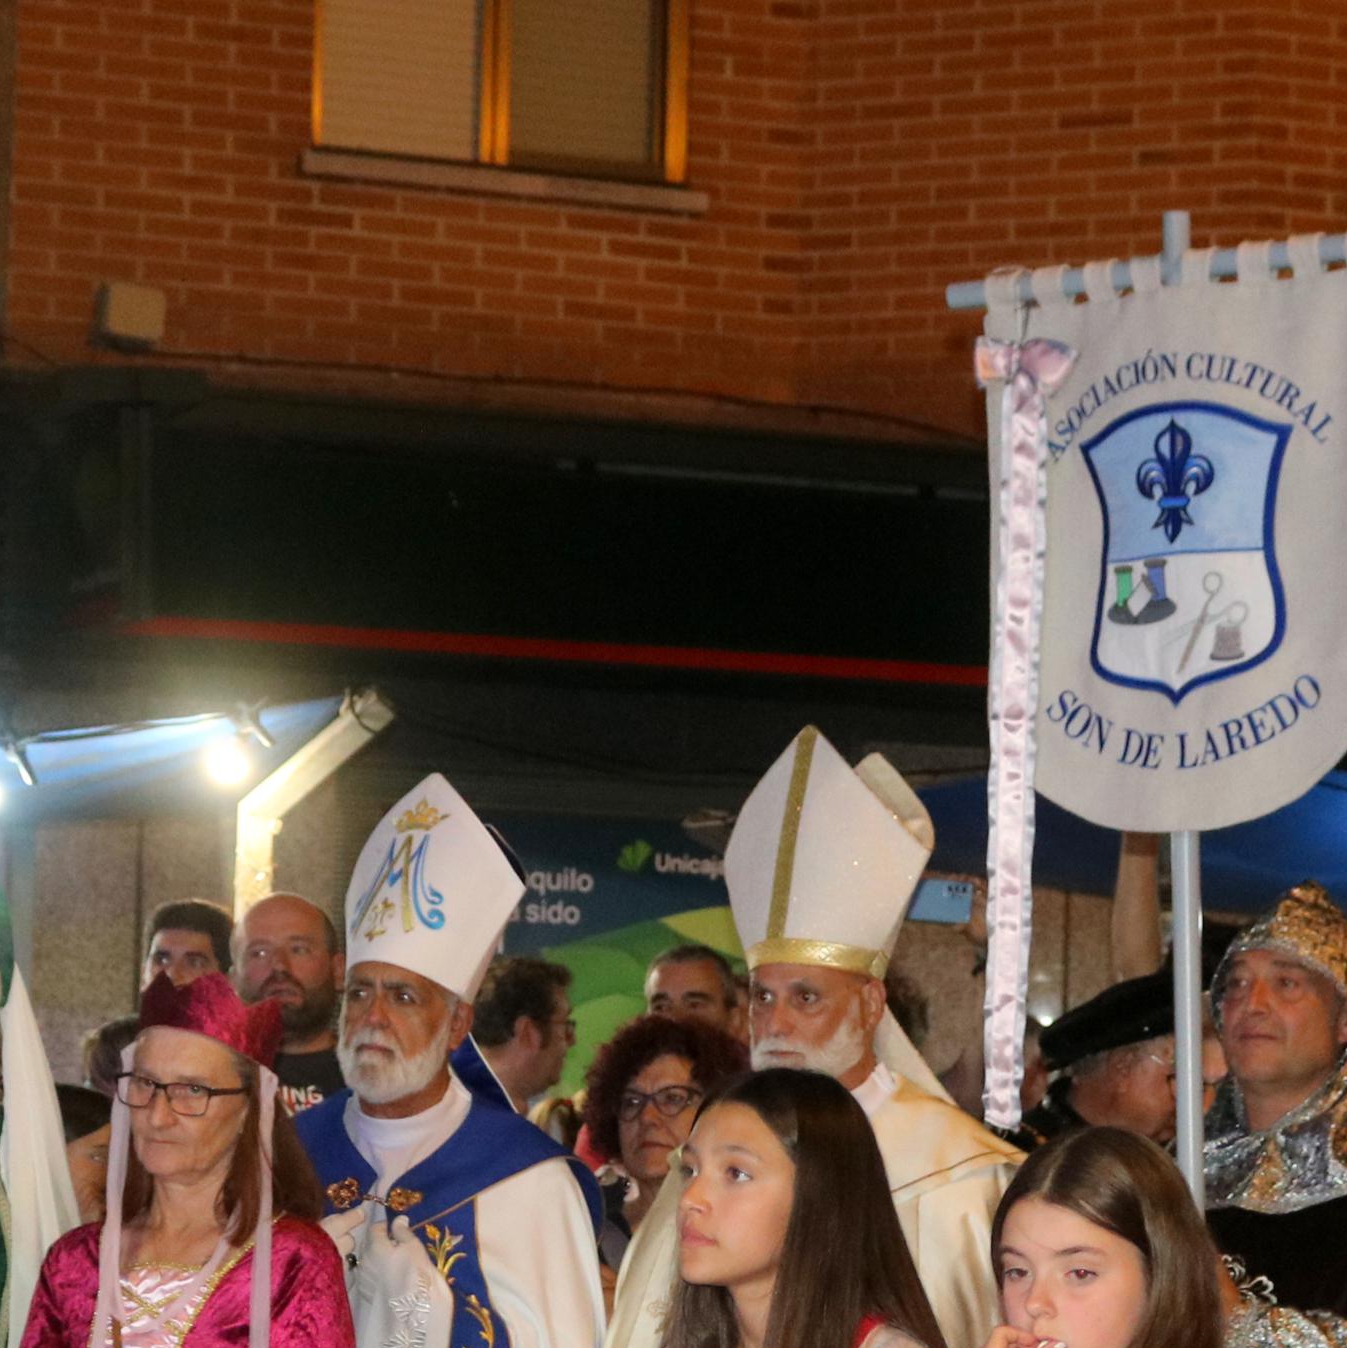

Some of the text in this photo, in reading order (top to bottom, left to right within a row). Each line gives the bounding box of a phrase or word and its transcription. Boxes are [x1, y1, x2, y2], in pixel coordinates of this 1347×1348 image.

[1042, 348, 1334, 466] ASOCIACIÓN CULTURAL
[1046, 674, 1322, 770] SON DE LAREDO
[526, 866, 595, 896] quilo
[525, 900, 582, 925] sido
[278, 1084, 324, 1106] ING
